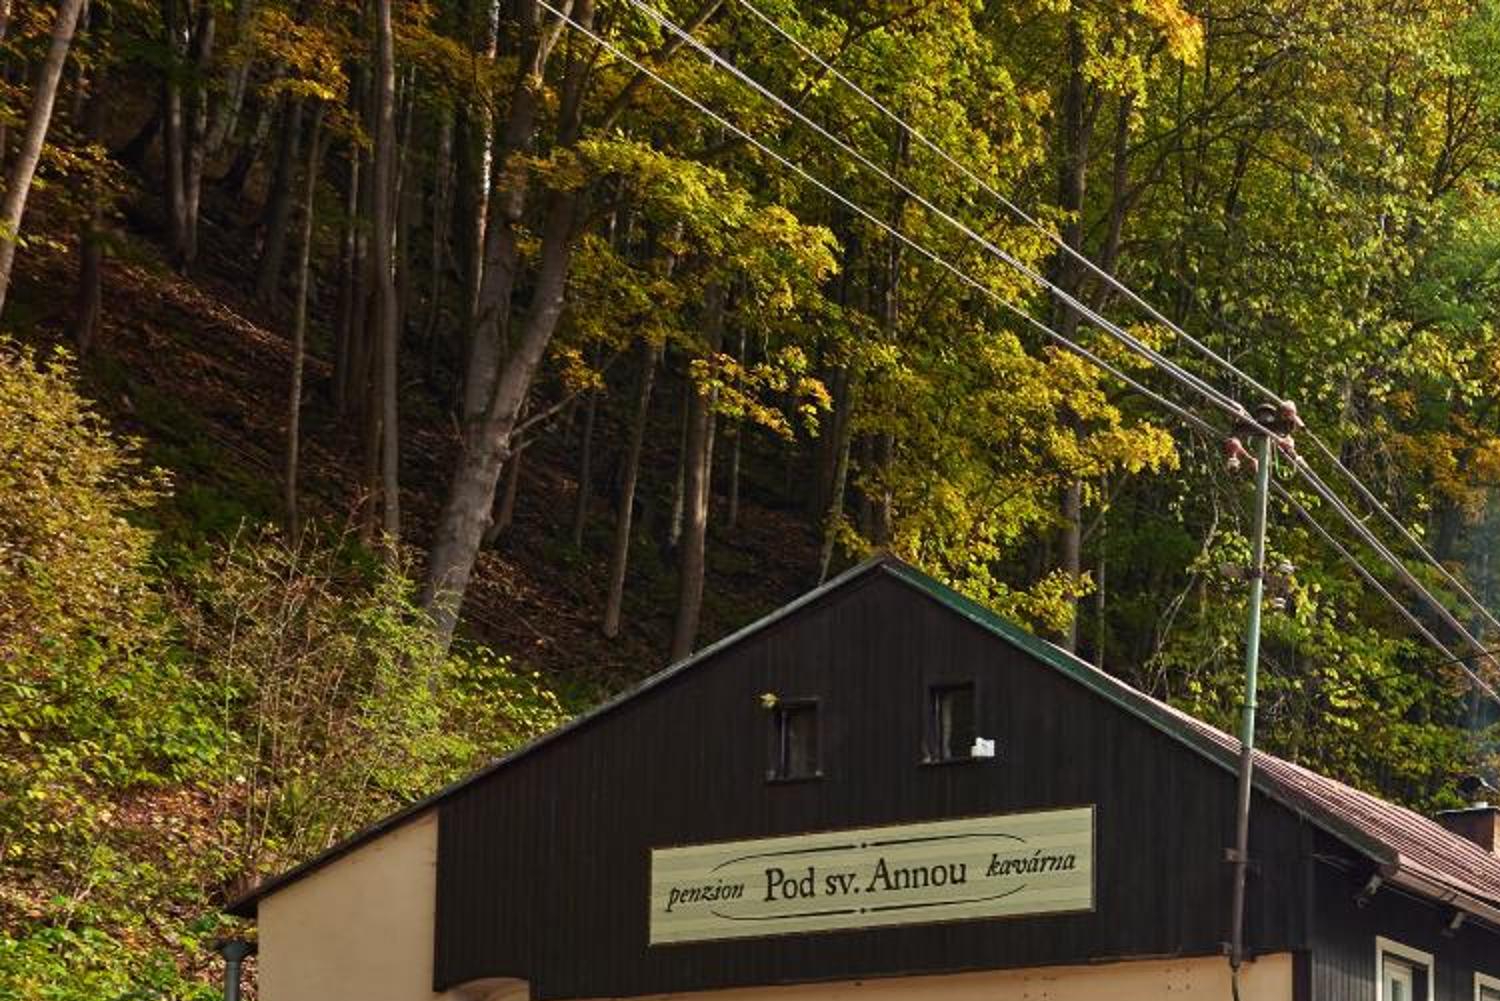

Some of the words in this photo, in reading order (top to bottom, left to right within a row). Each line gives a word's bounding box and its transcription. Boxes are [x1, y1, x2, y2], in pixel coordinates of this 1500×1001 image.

[665, 879, 744, 912] penzion
[763, 866, 816, 902] Pod
[825, 873, 860, 896] sv.
[866, 857, 967, 893] Annou
[985, 850, 1076, 877] kavárna
